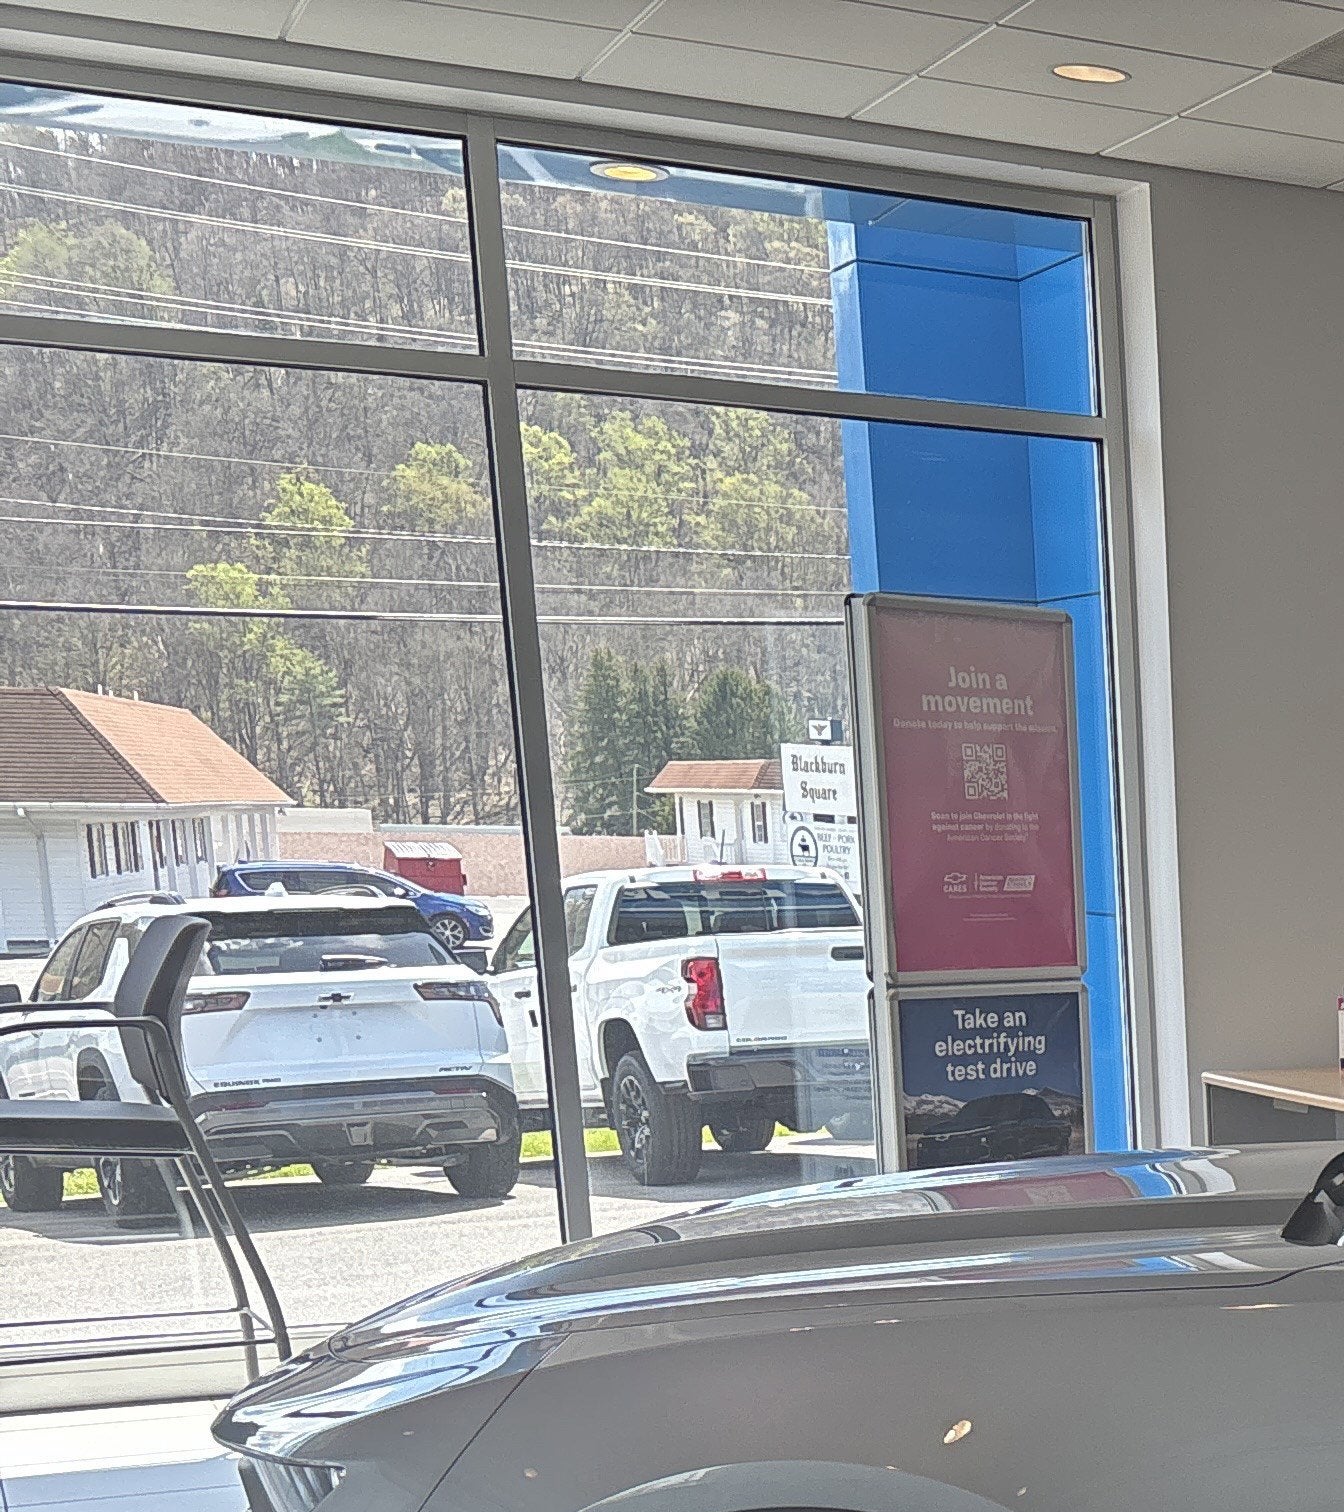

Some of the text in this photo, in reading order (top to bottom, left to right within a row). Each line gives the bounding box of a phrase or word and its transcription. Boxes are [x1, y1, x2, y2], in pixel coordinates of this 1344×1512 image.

[948, 665, 1008, 690] Join a
[922, 694, 1034, 716] movement
[791, 754, 846, 775] Blackburn
[800, 781, 838, 803] Square
[953, 1009, 1028, 1030] Take an
[934, 1033, 1046, 1058] electrifying
[946, 1057, 1037, 1081] test drive
